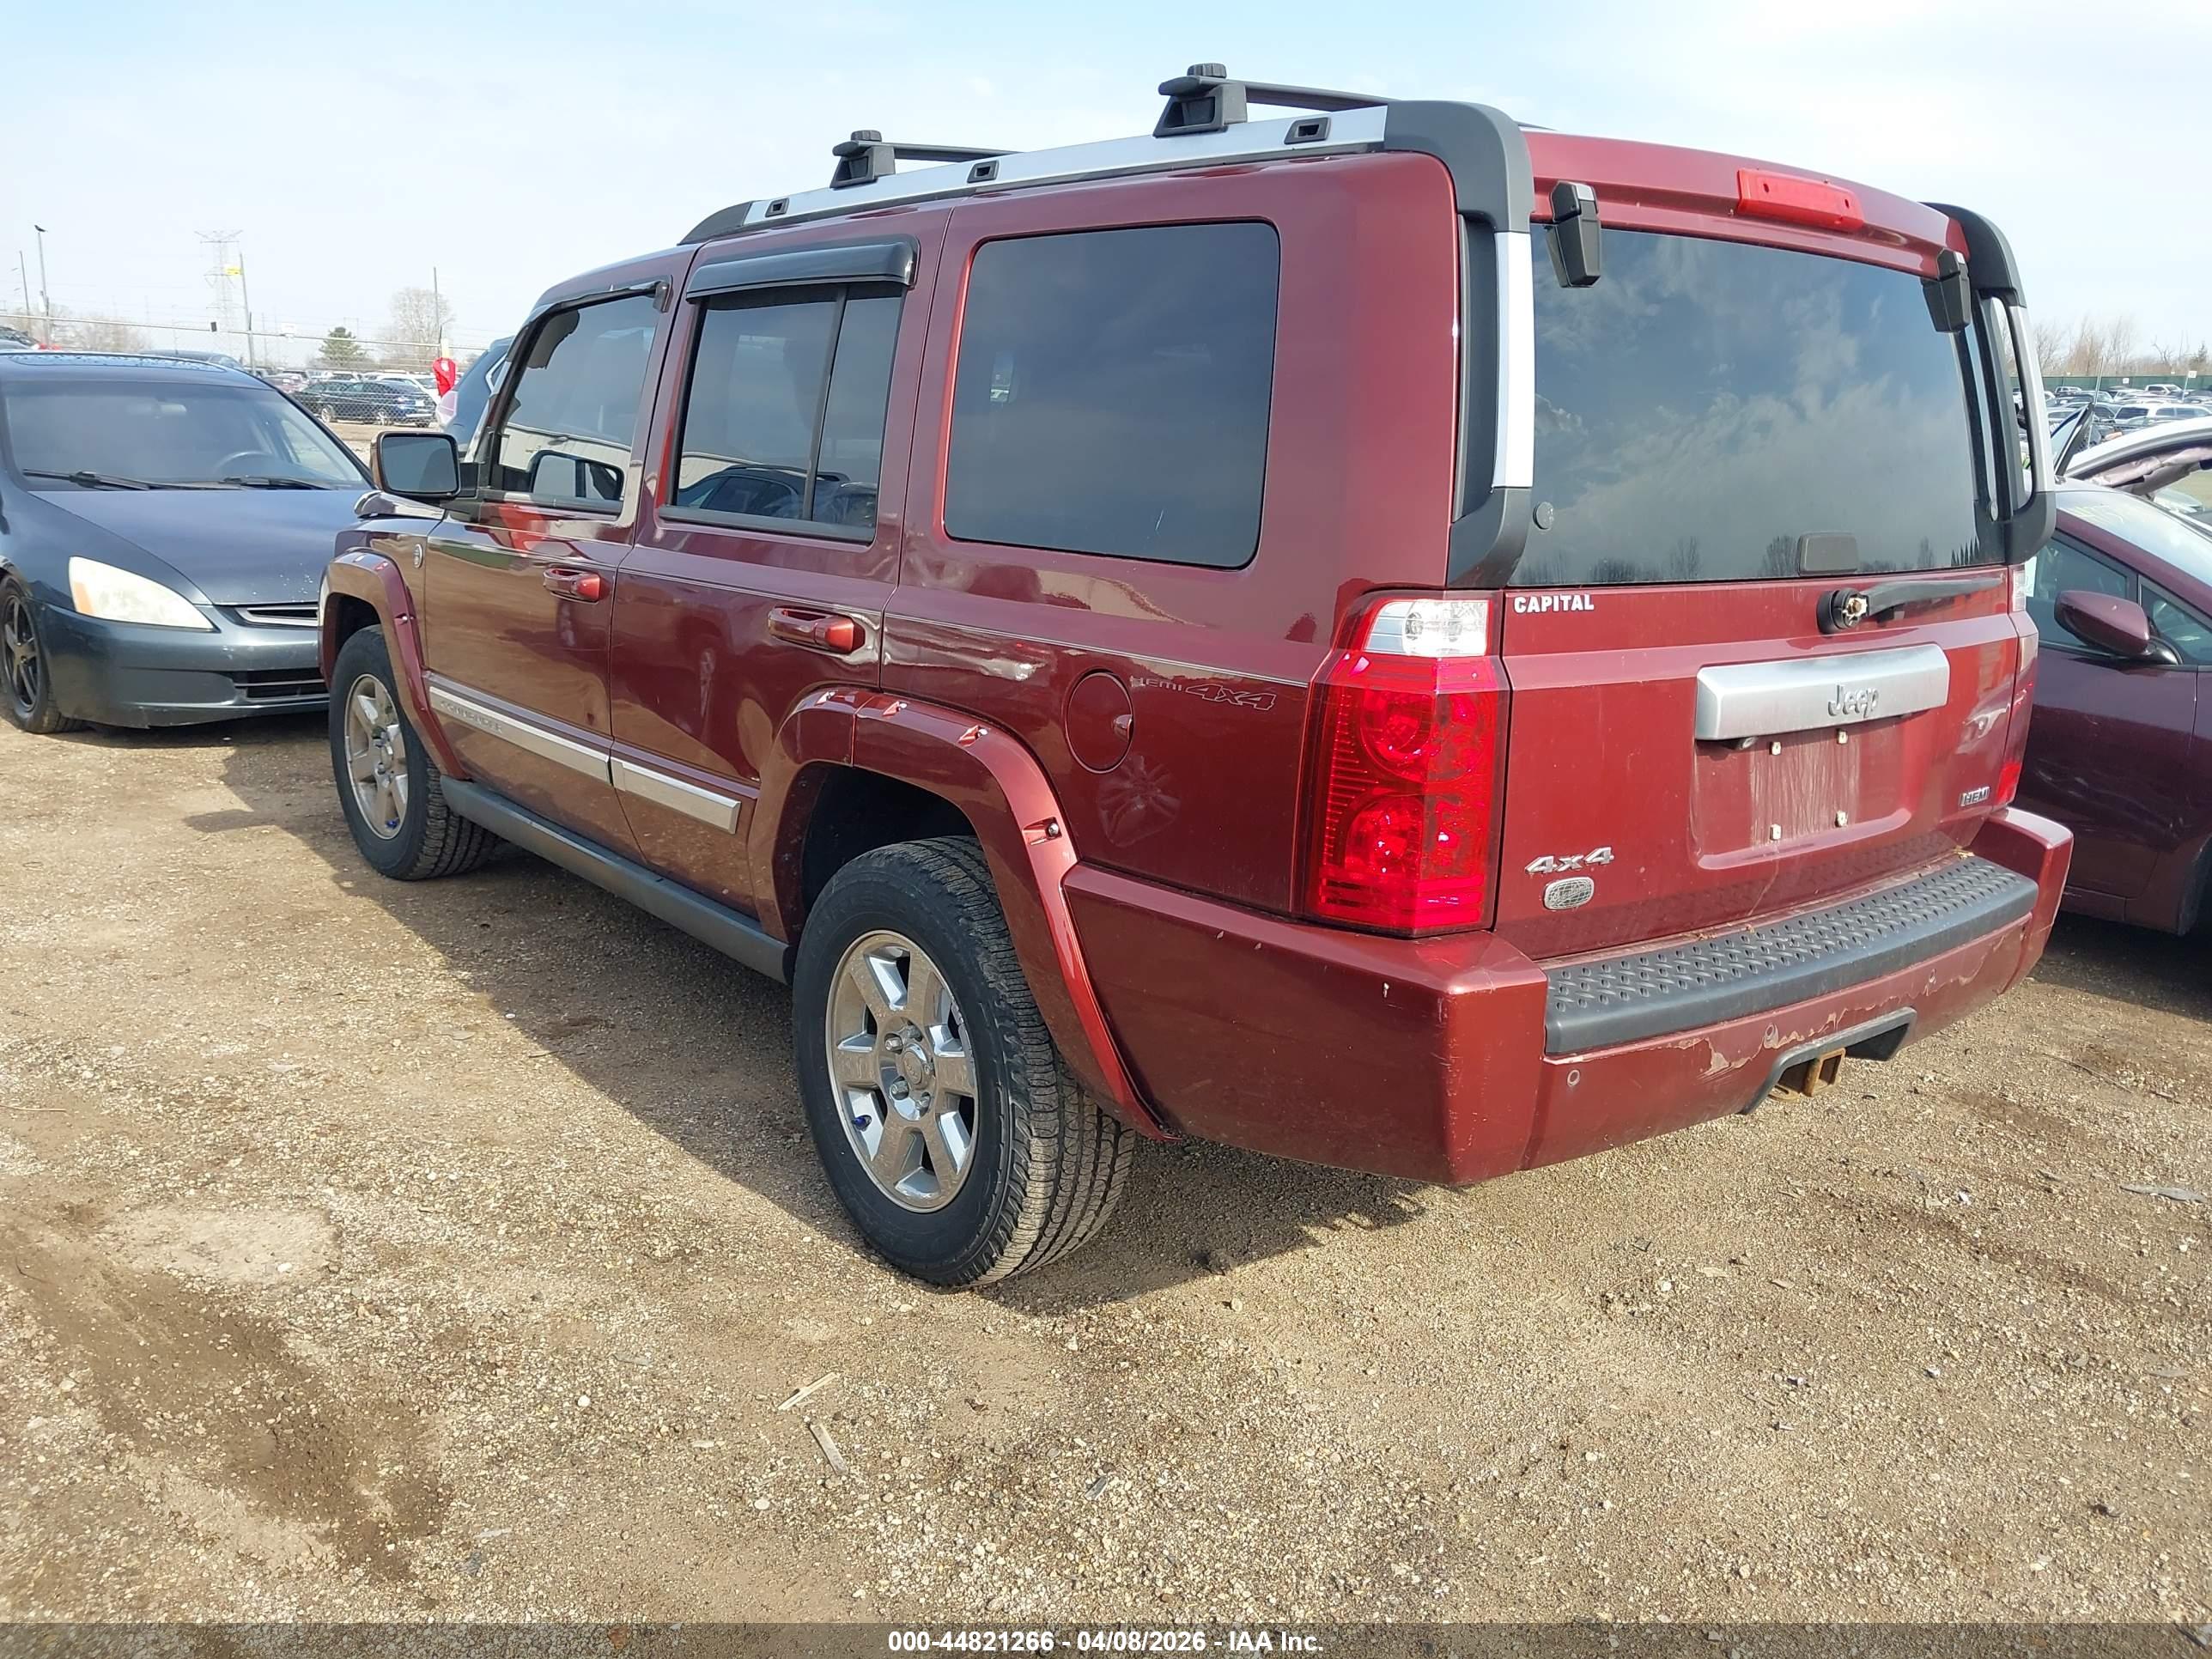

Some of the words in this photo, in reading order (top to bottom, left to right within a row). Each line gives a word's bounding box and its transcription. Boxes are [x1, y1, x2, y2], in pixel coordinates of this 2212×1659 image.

[1514, 593, 1595, 613] CAPITAL
[1185, 684, 1277, 711] 4x4
[1827, 684, 1879, 719] Jeep
[1960, 786, 1990, 807] HEMI
[1524, 847, 1615, 873] 4x4
